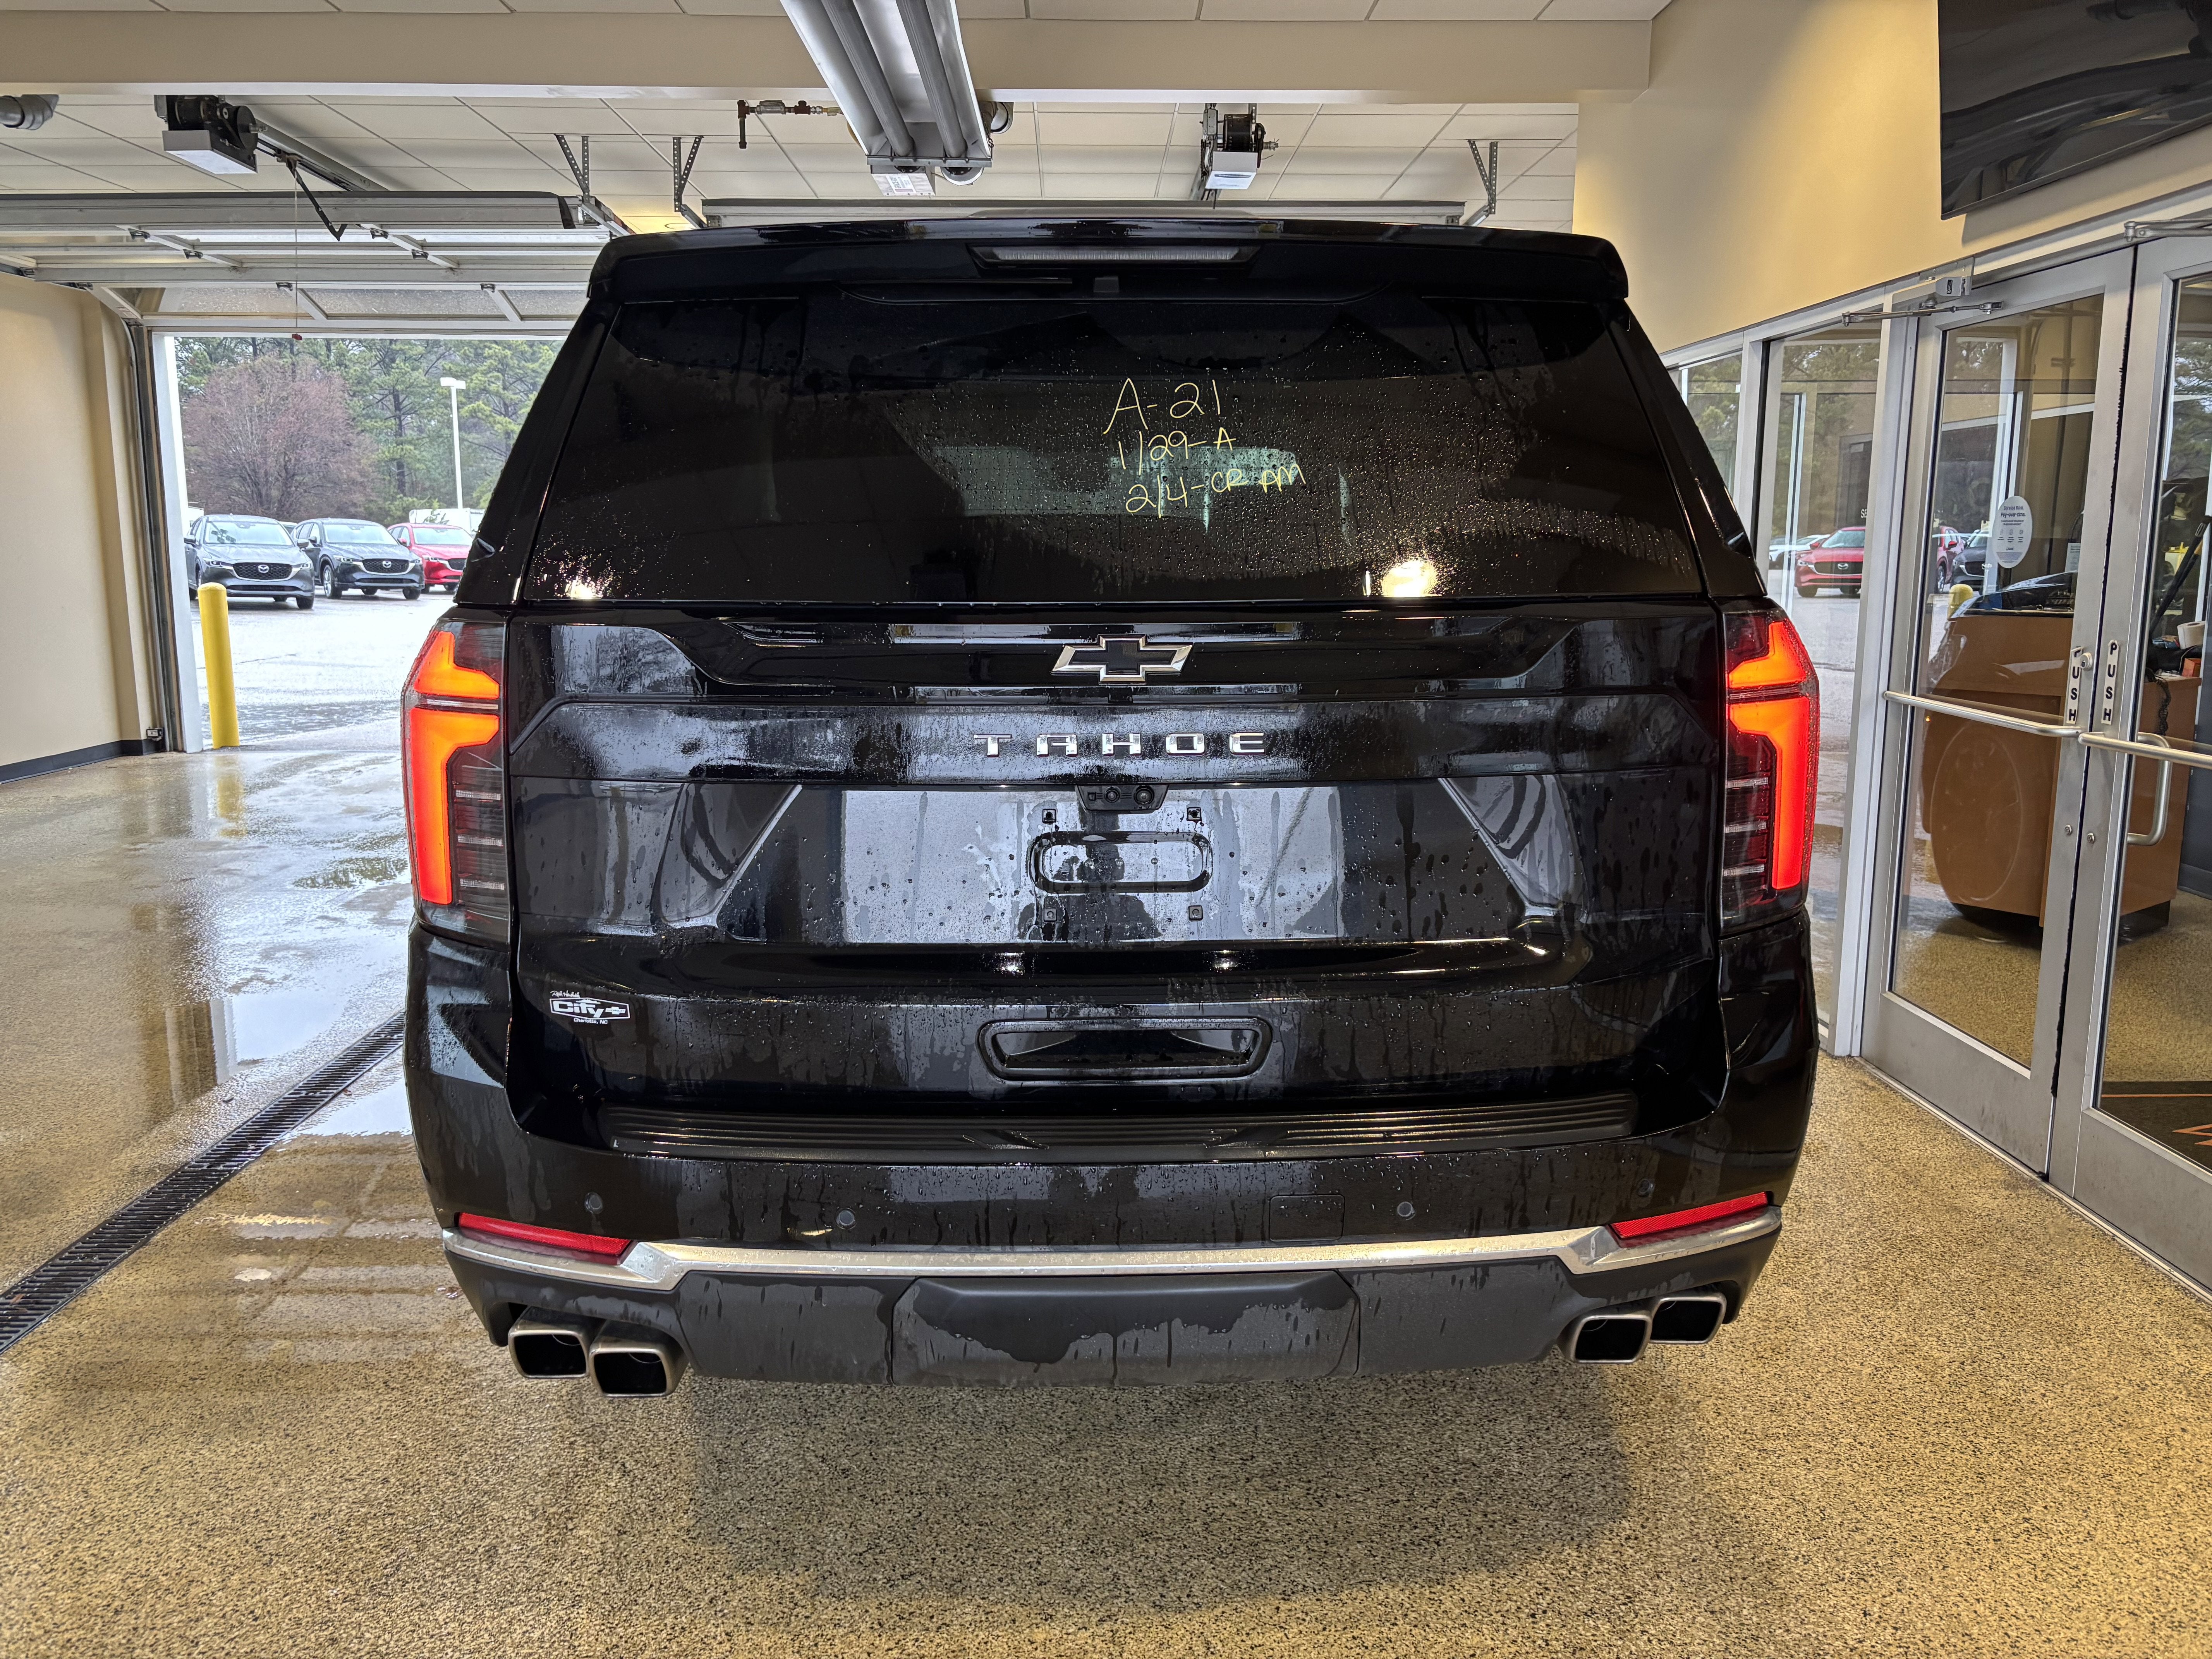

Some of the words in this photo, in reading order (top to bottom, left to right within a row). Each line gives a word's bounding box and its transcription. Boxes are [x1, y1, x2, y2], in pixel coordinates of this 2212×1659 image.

[2103, 642, 2118, 721] PUSH
[973, 732, 1265, 756] TAHOE
[553, 1001, 604, 1018] City
